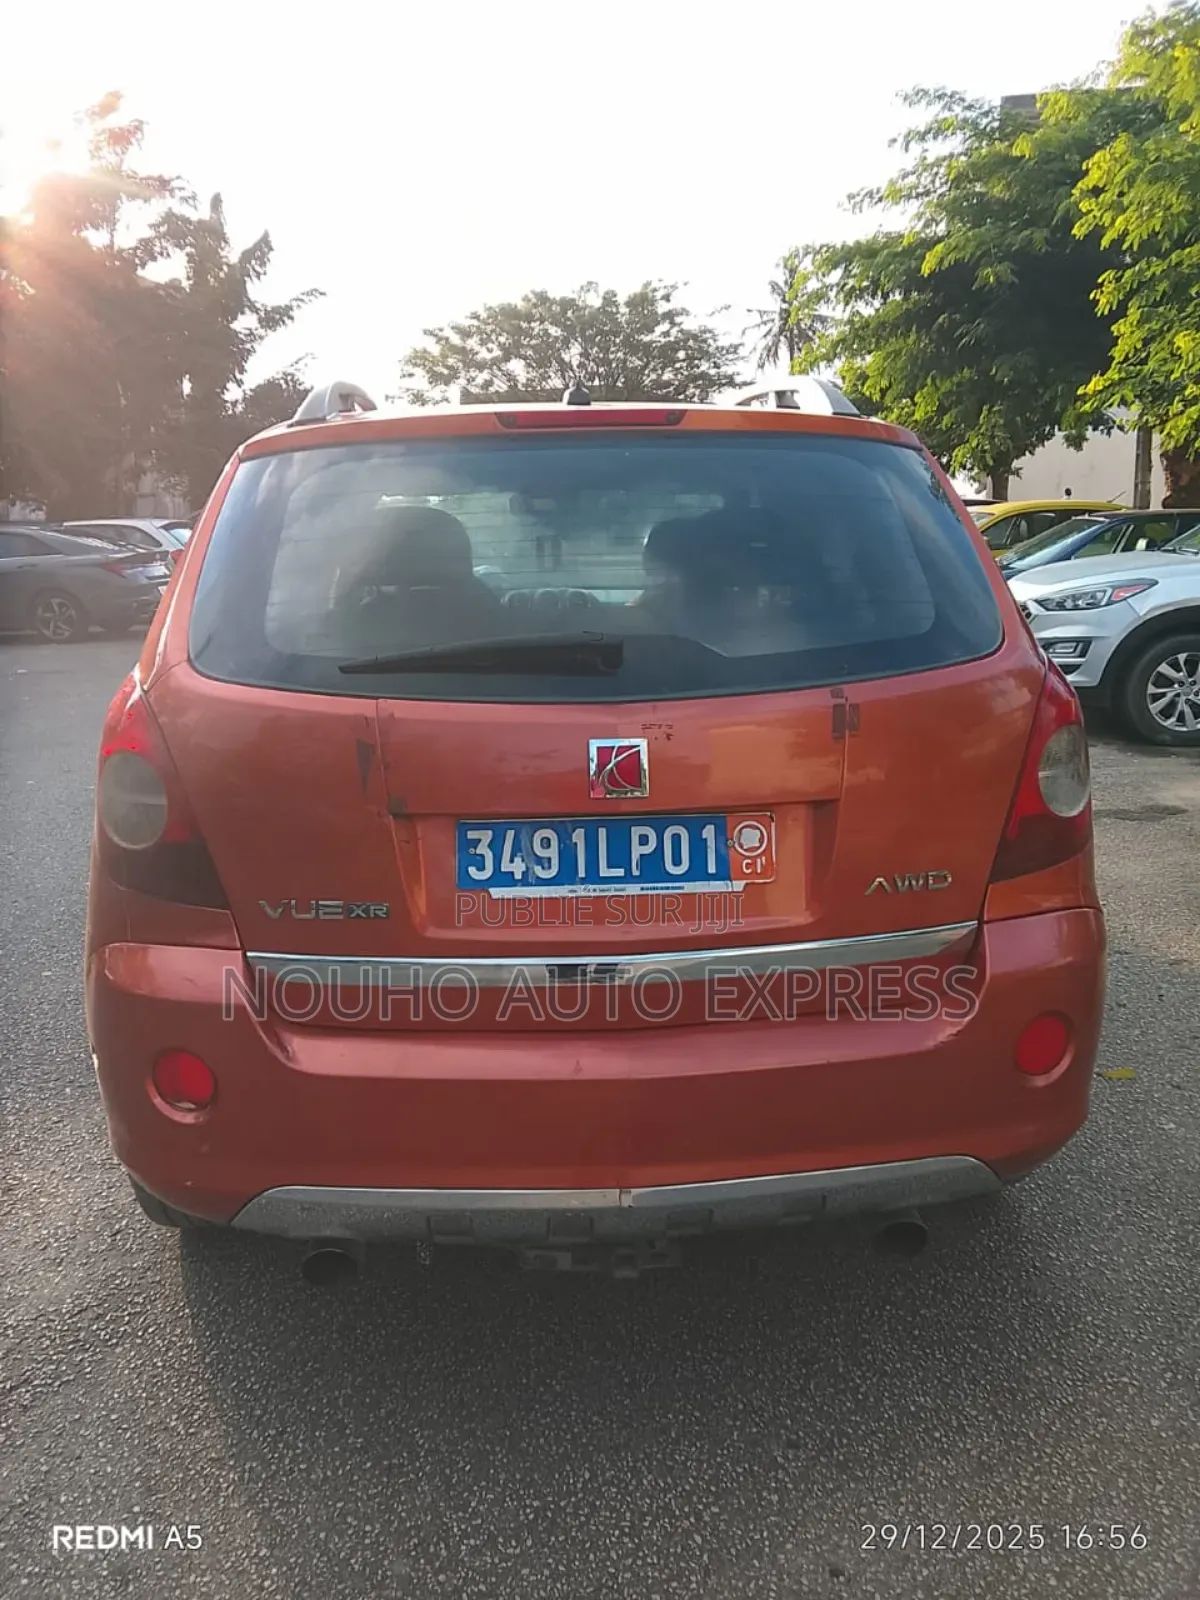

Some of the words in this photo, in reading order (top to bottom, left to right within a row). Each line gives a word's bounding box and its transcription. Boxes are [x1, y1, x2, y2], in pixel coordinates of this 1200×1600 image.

[466, 824, 717, 880] 3491LP01
[864, 870, 952, 896] AWD
[258, 899, 344, 919] VUE
[349, 902, 389, 919] XR
